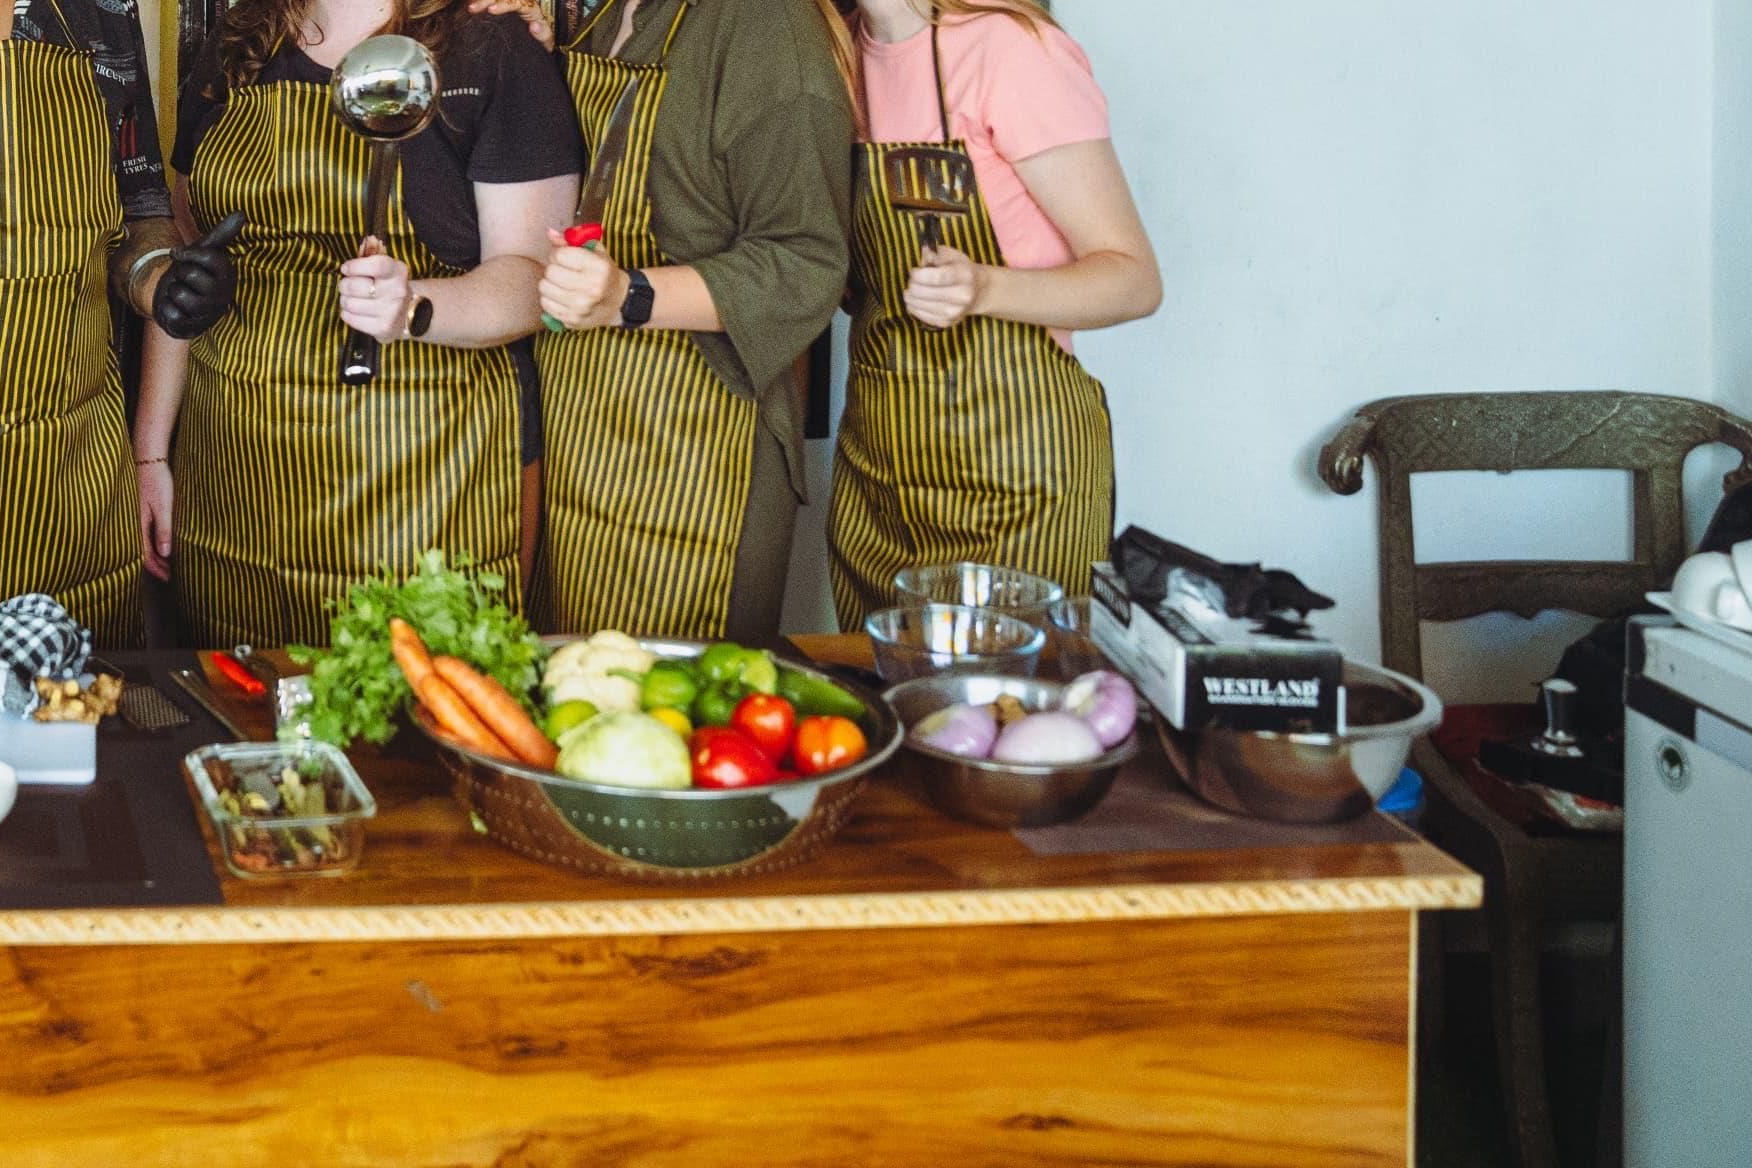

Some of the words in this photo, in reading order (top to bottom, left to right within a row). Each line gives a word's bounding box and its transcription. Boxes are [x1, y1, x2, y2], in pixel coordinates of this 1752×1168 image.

[94, 63, 128, 86] IRCUIT
[122, 155, 146, 167] FRESH
[124, 164, 149, 174] TYRES
[1203, 677, 1319, 697] WESTLAND
